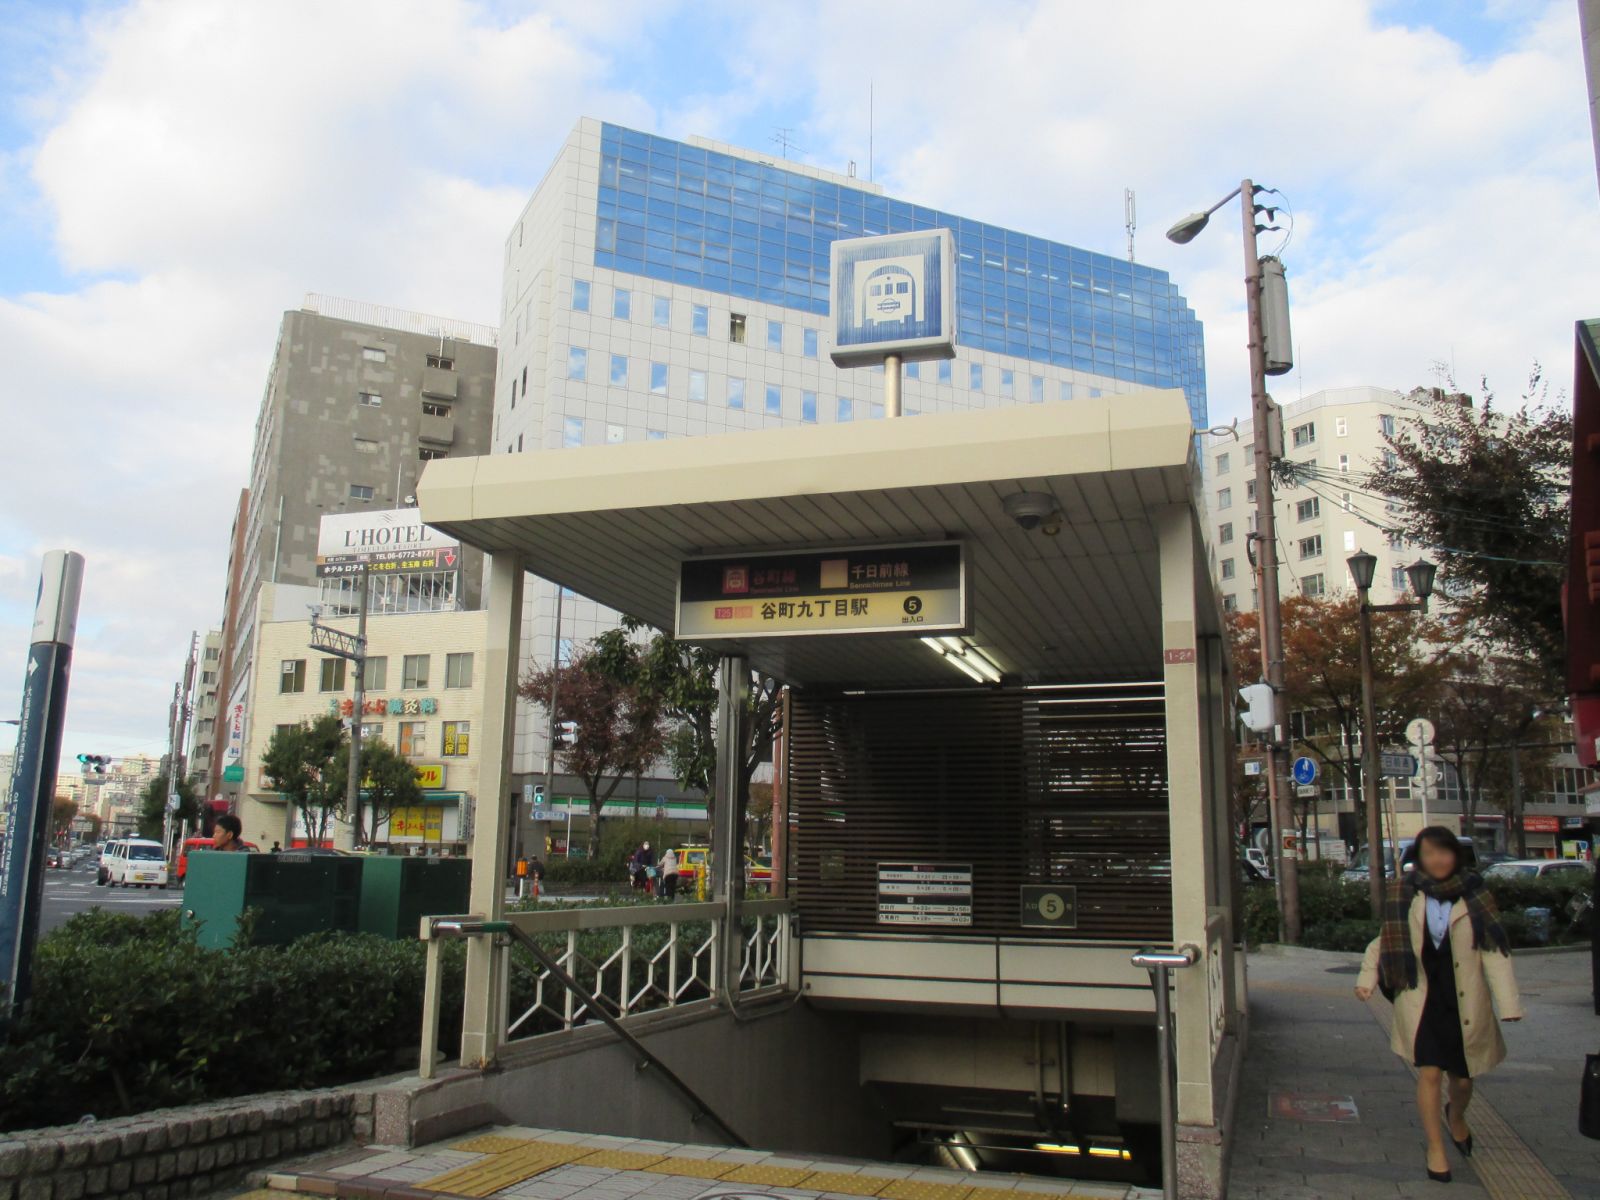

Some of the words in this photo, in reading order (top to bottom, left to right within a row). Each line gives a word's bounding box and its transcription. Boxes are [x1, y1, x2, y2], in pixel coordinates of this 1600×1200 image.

[344, 525, 432, 547] L'HOTEL
[851, 562, 910, 579] 千日前線
[760, 598, 869, 620] 谷町九丁目駅
[901, 616, 924, 624] 出入口
[1046, 899, 1057, 914] 5
